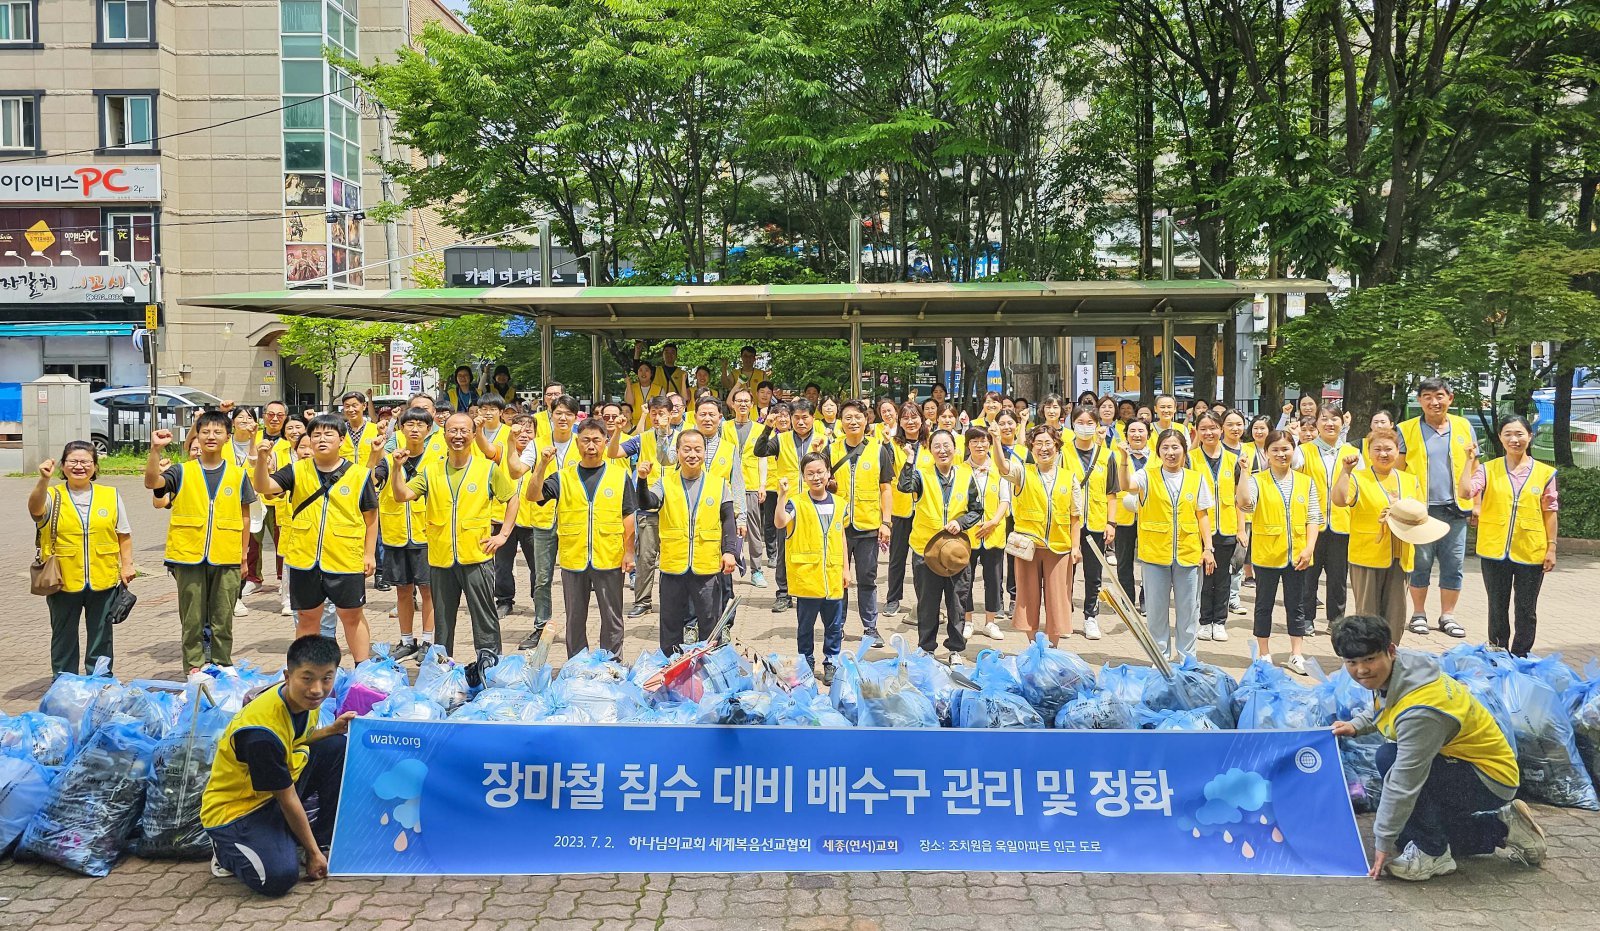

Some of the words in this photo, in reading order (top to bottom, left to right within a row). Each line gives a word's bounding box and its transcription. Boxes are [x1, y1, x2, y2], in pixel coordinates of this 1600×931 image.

[465, 267, 495, 285] 카페
[500, 267, 513, 283] 더
[0, 271, 57, 299] 자갈치
[392, 355, 403, 395] 드라이
[370, 733, 421, 748] watv.org
[482, 761, 604, 810] 장마철
[619, 763, 701, 812] 침수
[713, 765, 793, 813] 대비
[807, 766, 931, 815] 배수구
[942, 768, 1023, 816] 관리
[1036, 769, 1078, 817] 및
[1089, 769, 1174, 818] 정화
[553, 835, 587, 848] 2023.
[591, 836, 600, 848] 7.
[604, 836, 615, 848] 2.
[629, 836, 705, 851] 하나님의교회
[708, 837, 811, 853] 세계복음선교협회
[822, 839, 898, 853] 세종(연서)교회
[919, 839, 945, 853] 장소:
[948, 839, 992, 853] 조치원읍
[995, 839, 1051, 853] 욱일아파트
[1054, 840, 1076, 853] 인근
[1080, 841, 1102, 852] 도로
